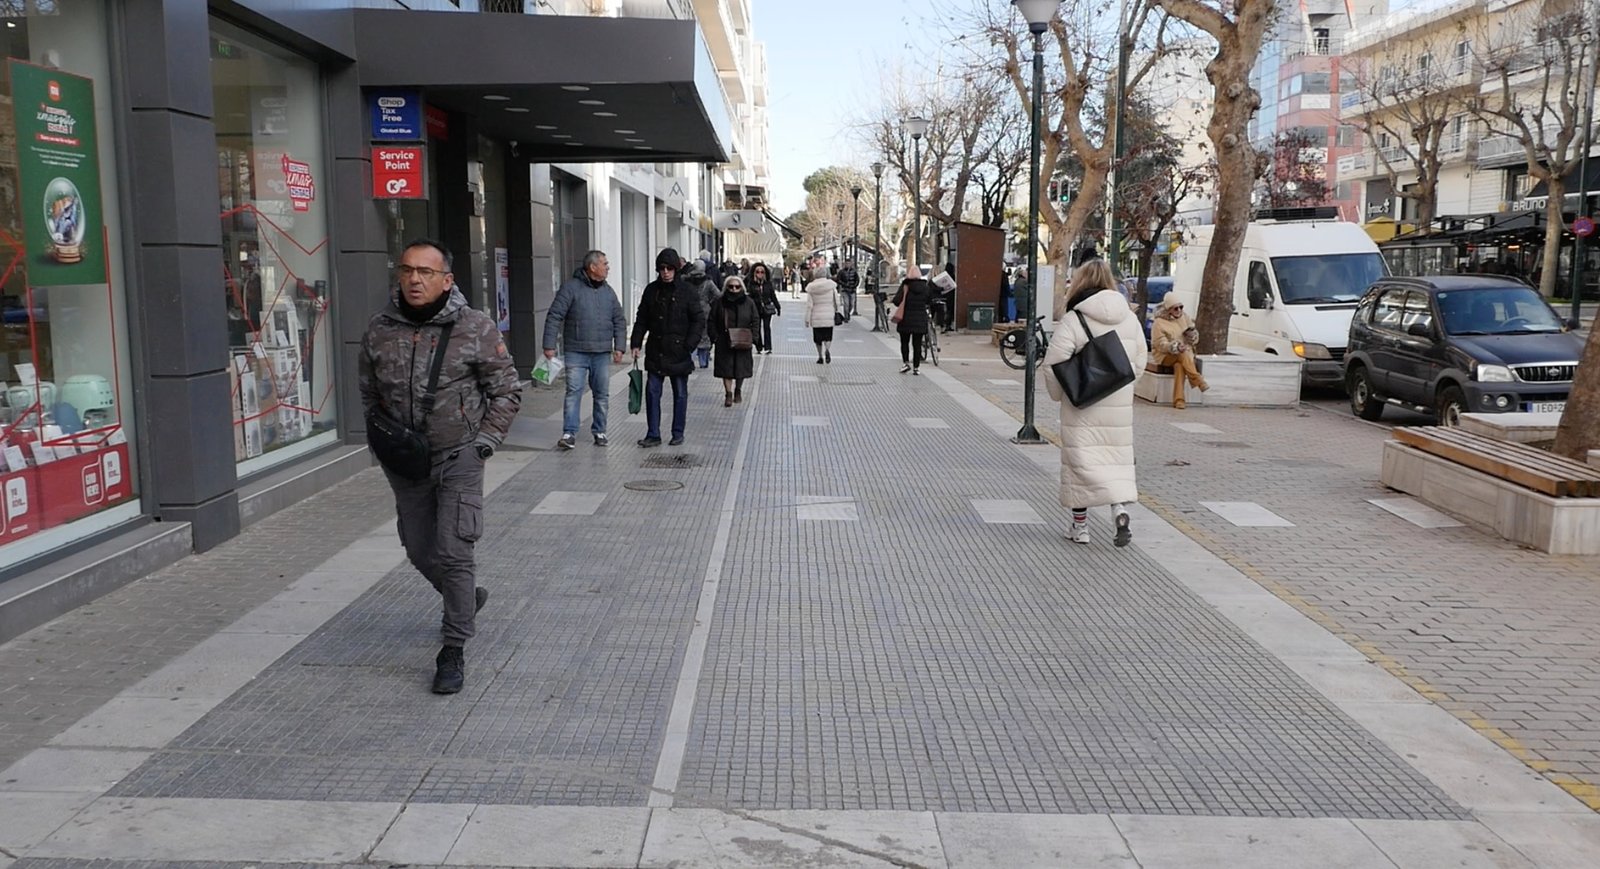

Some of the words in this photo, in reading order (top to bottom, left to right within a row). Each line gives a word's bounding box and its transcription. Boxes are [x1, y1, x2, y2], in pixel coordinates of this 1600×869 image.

[381, 97, 403, 107] Shop
[382, 114, 402, 122] Free
[380, 150, 415, 160] Service
[385, 161, 410, 170] Point
